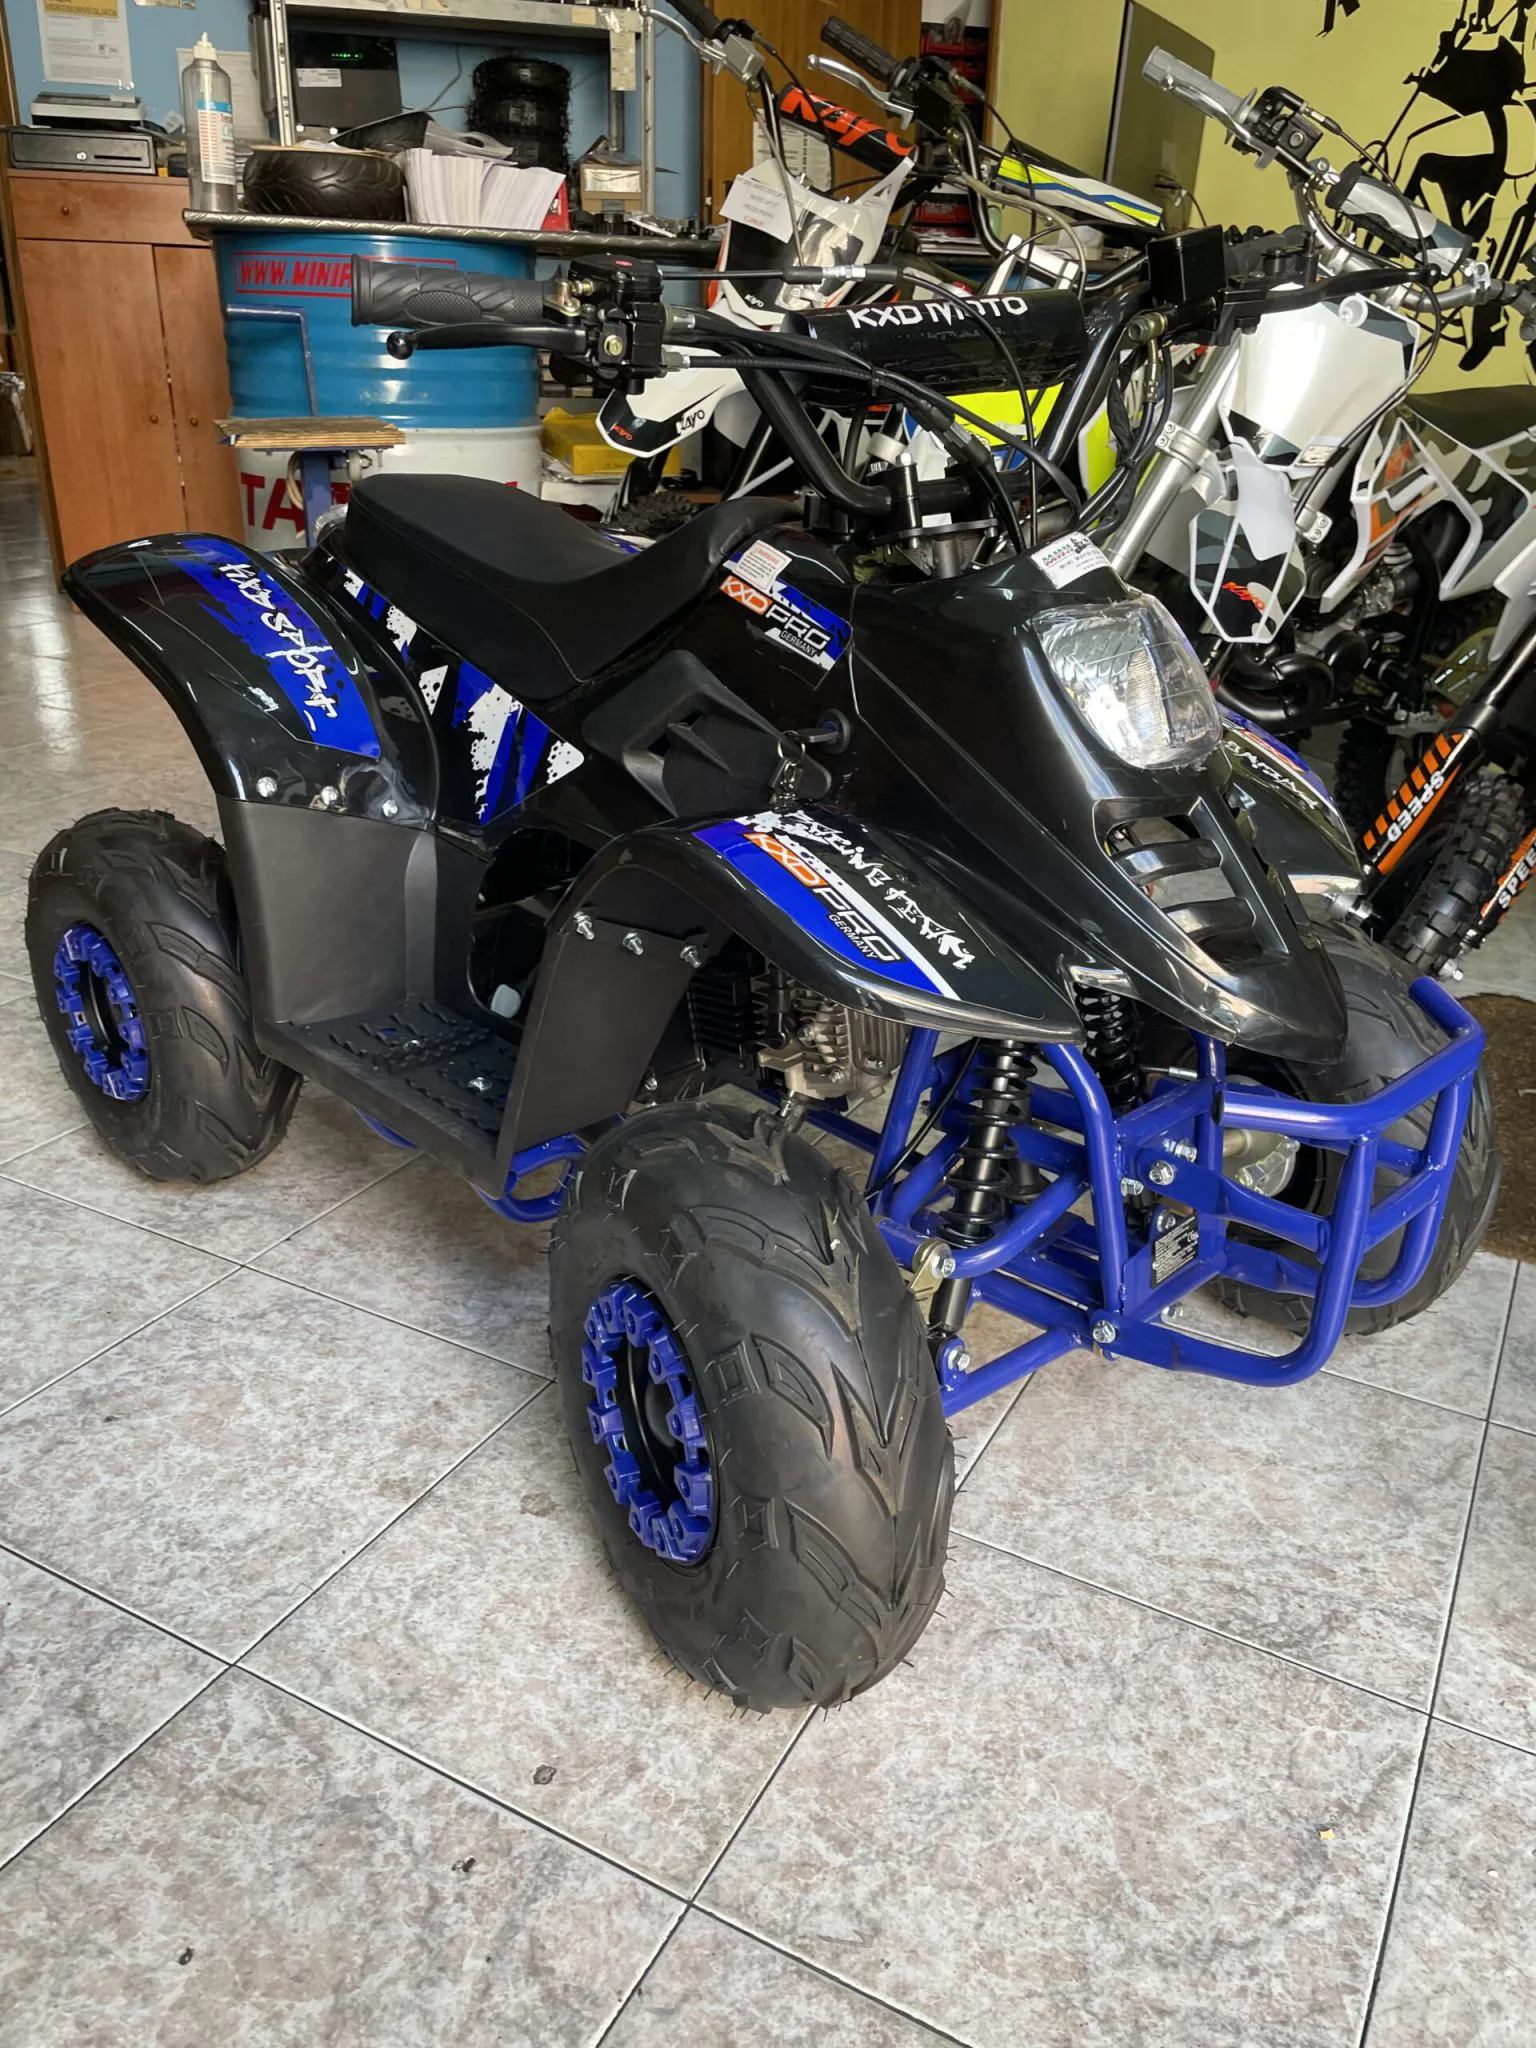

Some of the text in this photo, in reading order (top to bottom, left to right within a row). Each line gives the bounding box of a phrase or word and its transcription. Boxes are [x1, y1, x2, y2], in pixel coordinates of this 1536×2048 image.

[240, 260, 352, 289] WWW.MINIR
[846, 304, 923, 329] KXD
[720, 576, 831, 651] KXD PRO
[780, 630, 818, 656] GERMANY
[1387, 770, 1445, 842] SPEED
[746, 834, 901, 961] KXD PRO
[1499, 840, 1536, 909] SPEE
[828, 914, 878, 959] GERMANY
[884, 887, 976, 970] TEAM
